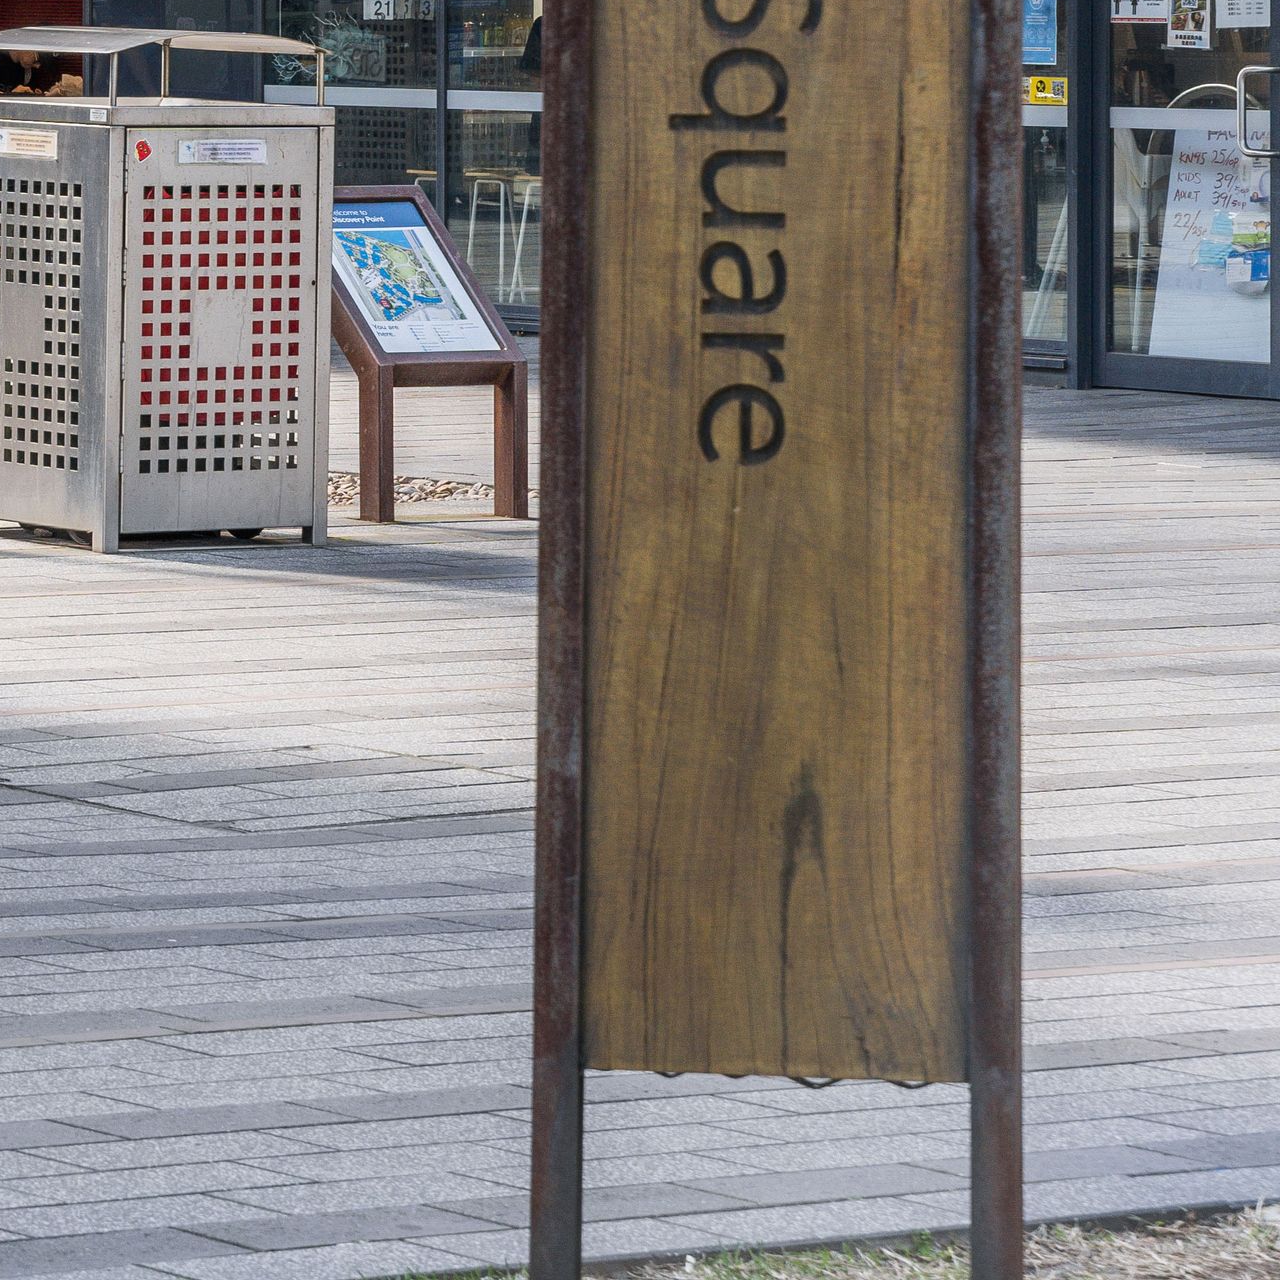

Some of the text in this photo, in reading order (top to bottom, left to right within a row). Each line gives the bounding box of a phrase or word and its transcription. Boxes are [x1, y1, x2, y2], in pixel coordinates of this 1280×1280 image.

[374, 0, 391, 17] 21
[1179, 151, 1208, 165] KN95
[1177, 172, 1202, 184] KIDS
[372, 323, 384, 331] You
